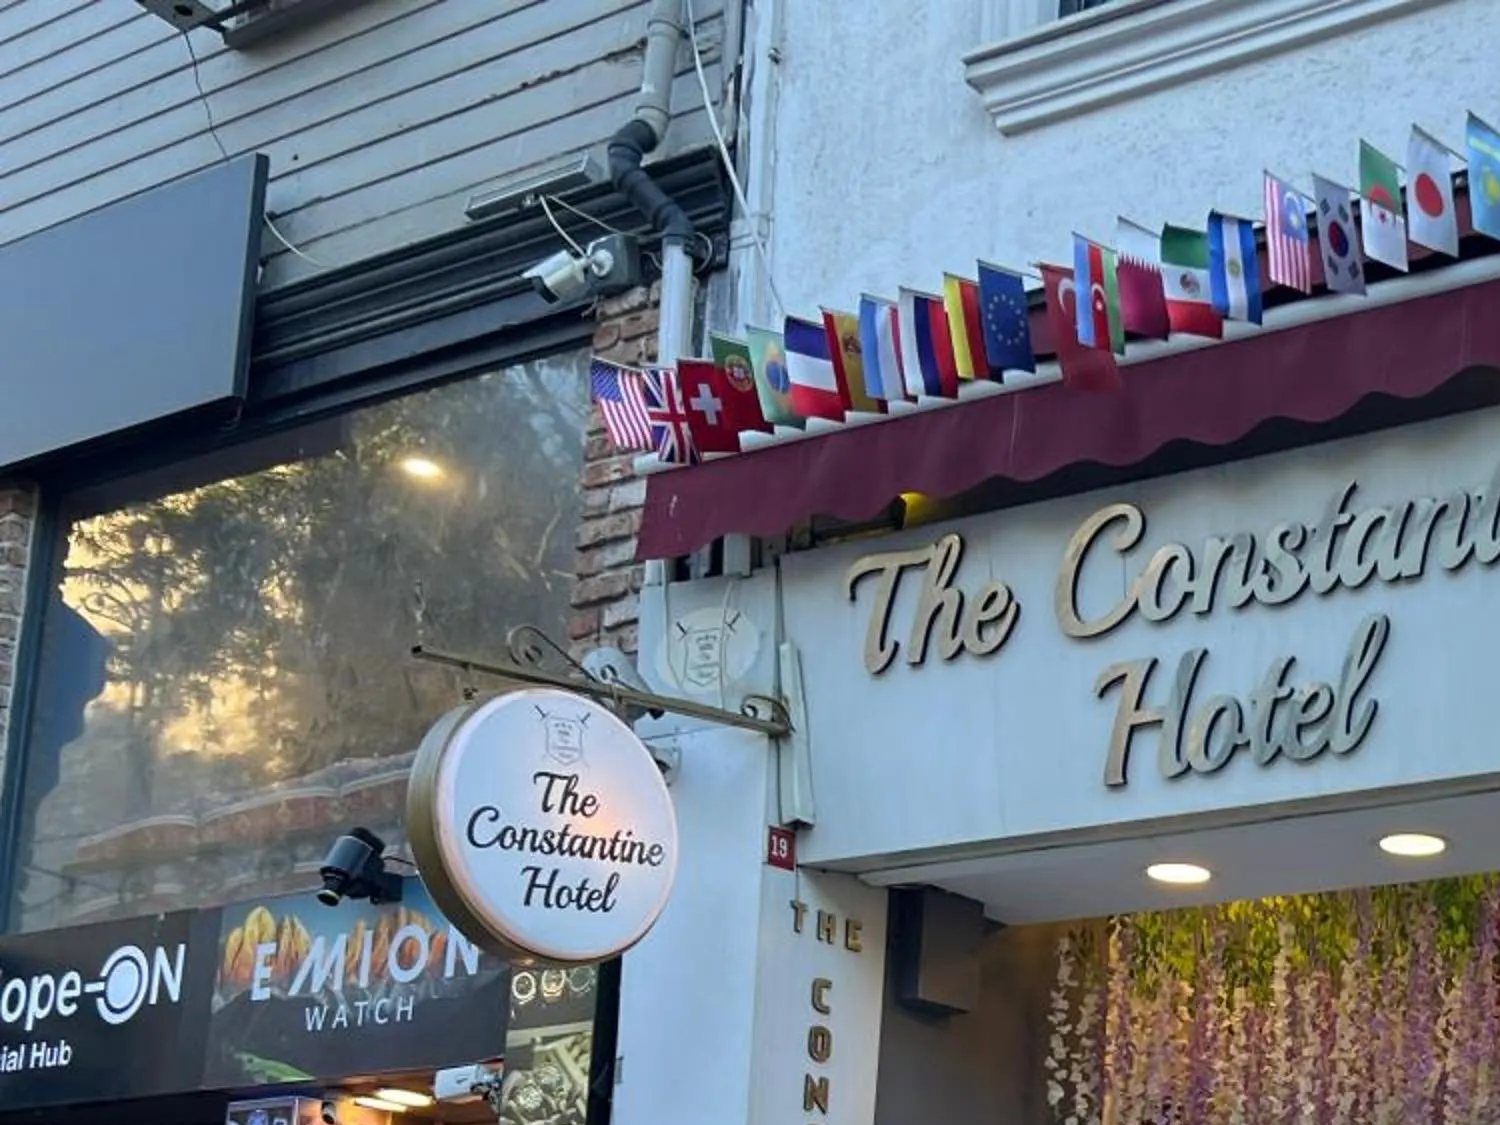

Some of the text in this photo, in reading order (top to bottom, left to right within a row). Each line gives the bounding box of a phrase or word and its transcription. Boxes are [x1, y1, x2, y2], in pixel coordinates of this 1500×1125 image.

[842, 531, 1023, 676] The
[1094, 612, 1392, 788] Hotel
[532, 770, 600, 818] The
[466, 805, 665, 867] Constantine
[771, 835, 789, 859] 19
[519, 865, 621, 913] Hotel
[789, 899, 864, 952] THE
[0, 943, 186, 1031] ope-ON
[304, 996, 415, 1032] WATCH
[0, 1039, 73, 1072] ial Hub
